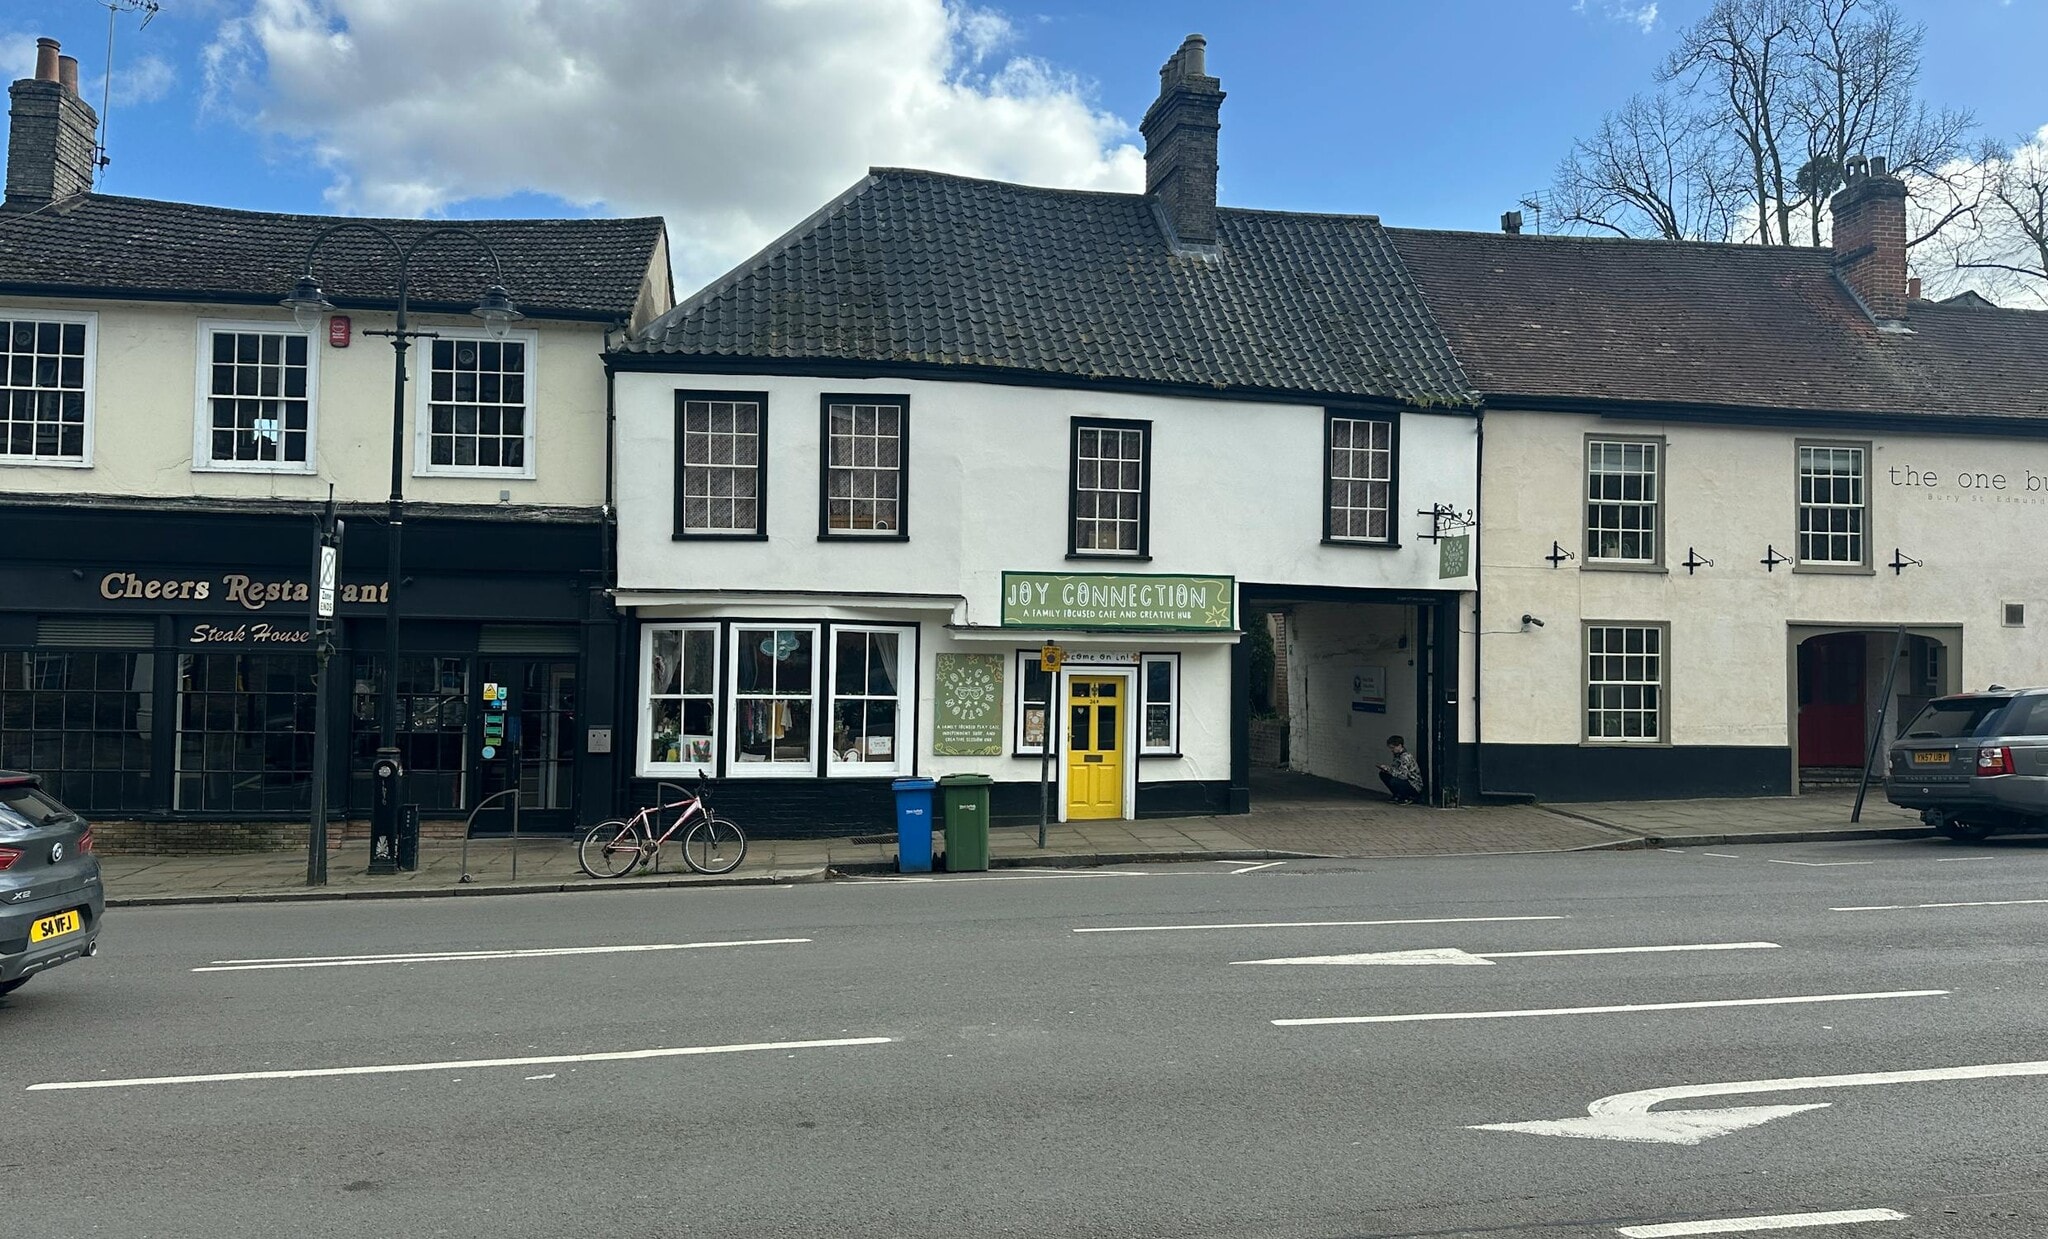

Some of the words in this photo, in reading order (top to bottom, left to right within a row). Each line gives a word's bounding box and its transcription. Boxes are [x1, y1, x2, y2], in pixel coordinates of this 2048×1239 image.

[1888, 465, 1938, 487] the
[1958, 472, 2006, 490] one
[1927, 493, 1960, 503] Bury
[1971, 494, 1984, 503] St
[100, 572, 210, 601] Cheers
[223, 574, 389, 609] Restaant
[1007, 581, 1050, 606] JOY
[1062, 582, 1206, 608] CONNECTION
[320, 602, 333, 612] ENDS
[1023, 609, 1030, 618] A
[1032, 609, 1060, 618] FAMILY
[1063, 609, 1096, 619] FOCUSED
[1098, 609, 1117, 619] CAFE
[1119, 610, 1137, 619] AND
[1139, 610, 1175, 620] CREATIVE
[1177, 611, 1192, 620] HUB
[190, 624, 246, 643] Steak
[250, 623, 310, 643] House
[41, 920, 54, 937] S4
[54, 915, 72, 933] VFJ
